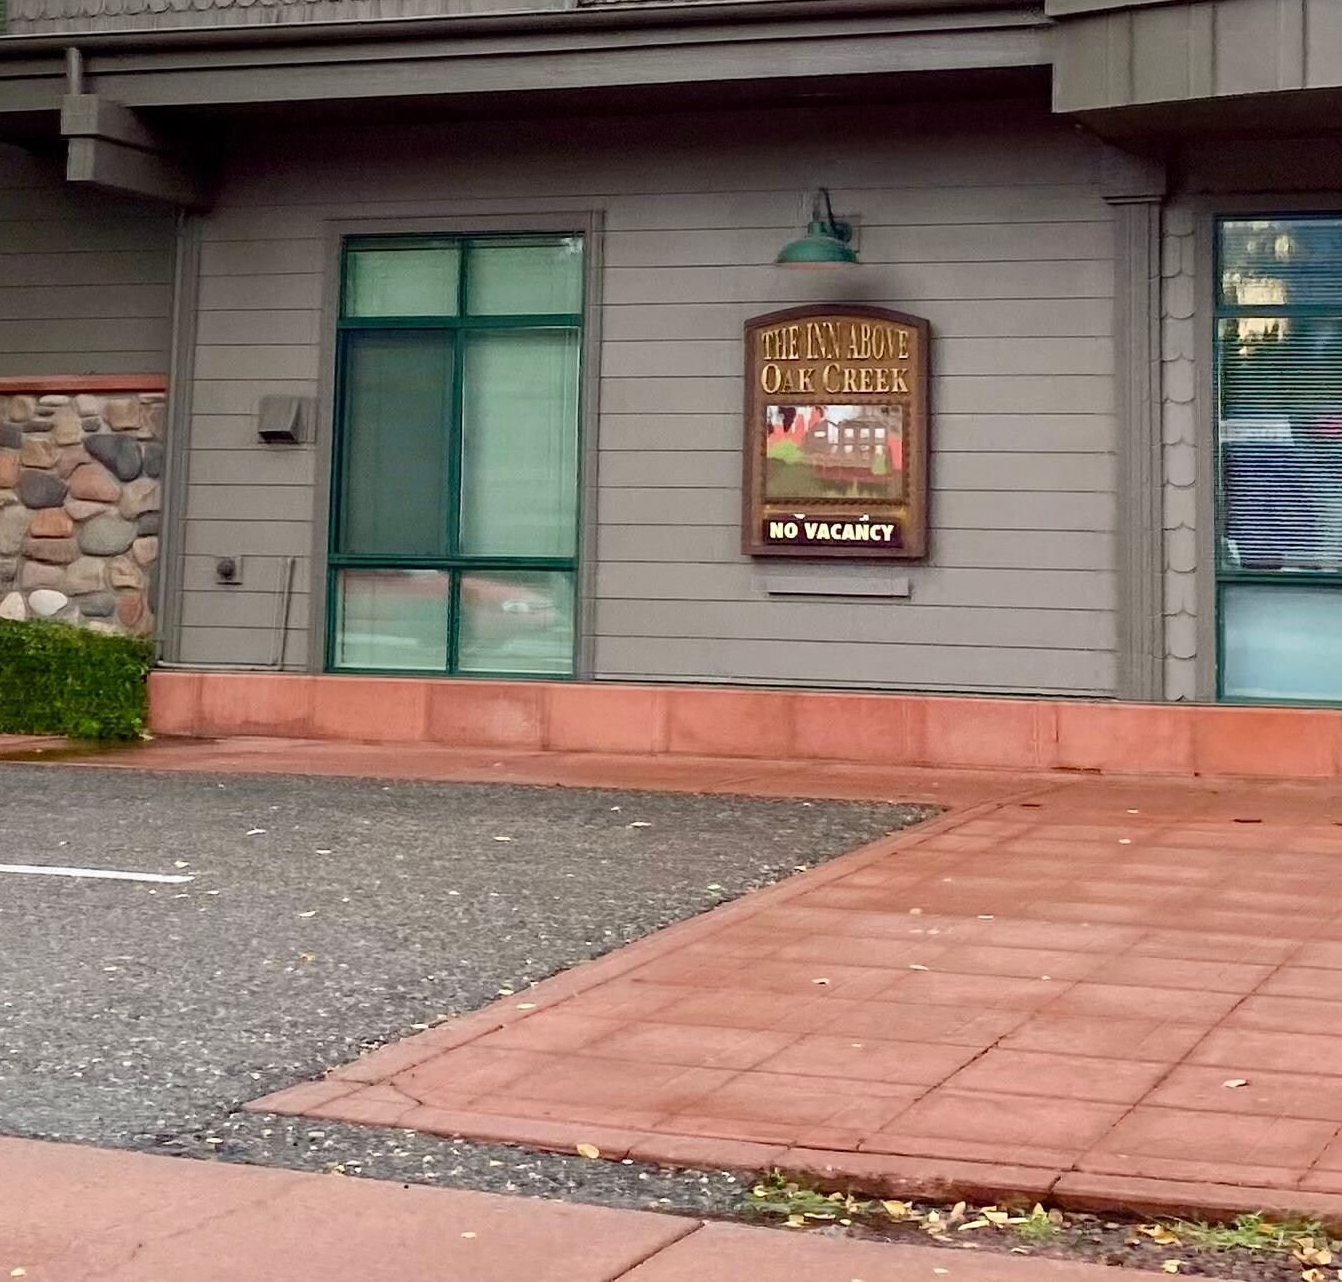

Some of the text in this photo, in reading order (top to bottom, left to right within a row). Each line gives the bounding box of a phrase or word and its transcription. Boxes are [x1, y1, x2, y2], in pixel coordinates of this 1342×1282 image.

[762, 322, 909, 360] THE INN ABOVE
[761, 363, 908, 393] OAK CREEK
[770, 522, 894, 542] NO VACANCY
